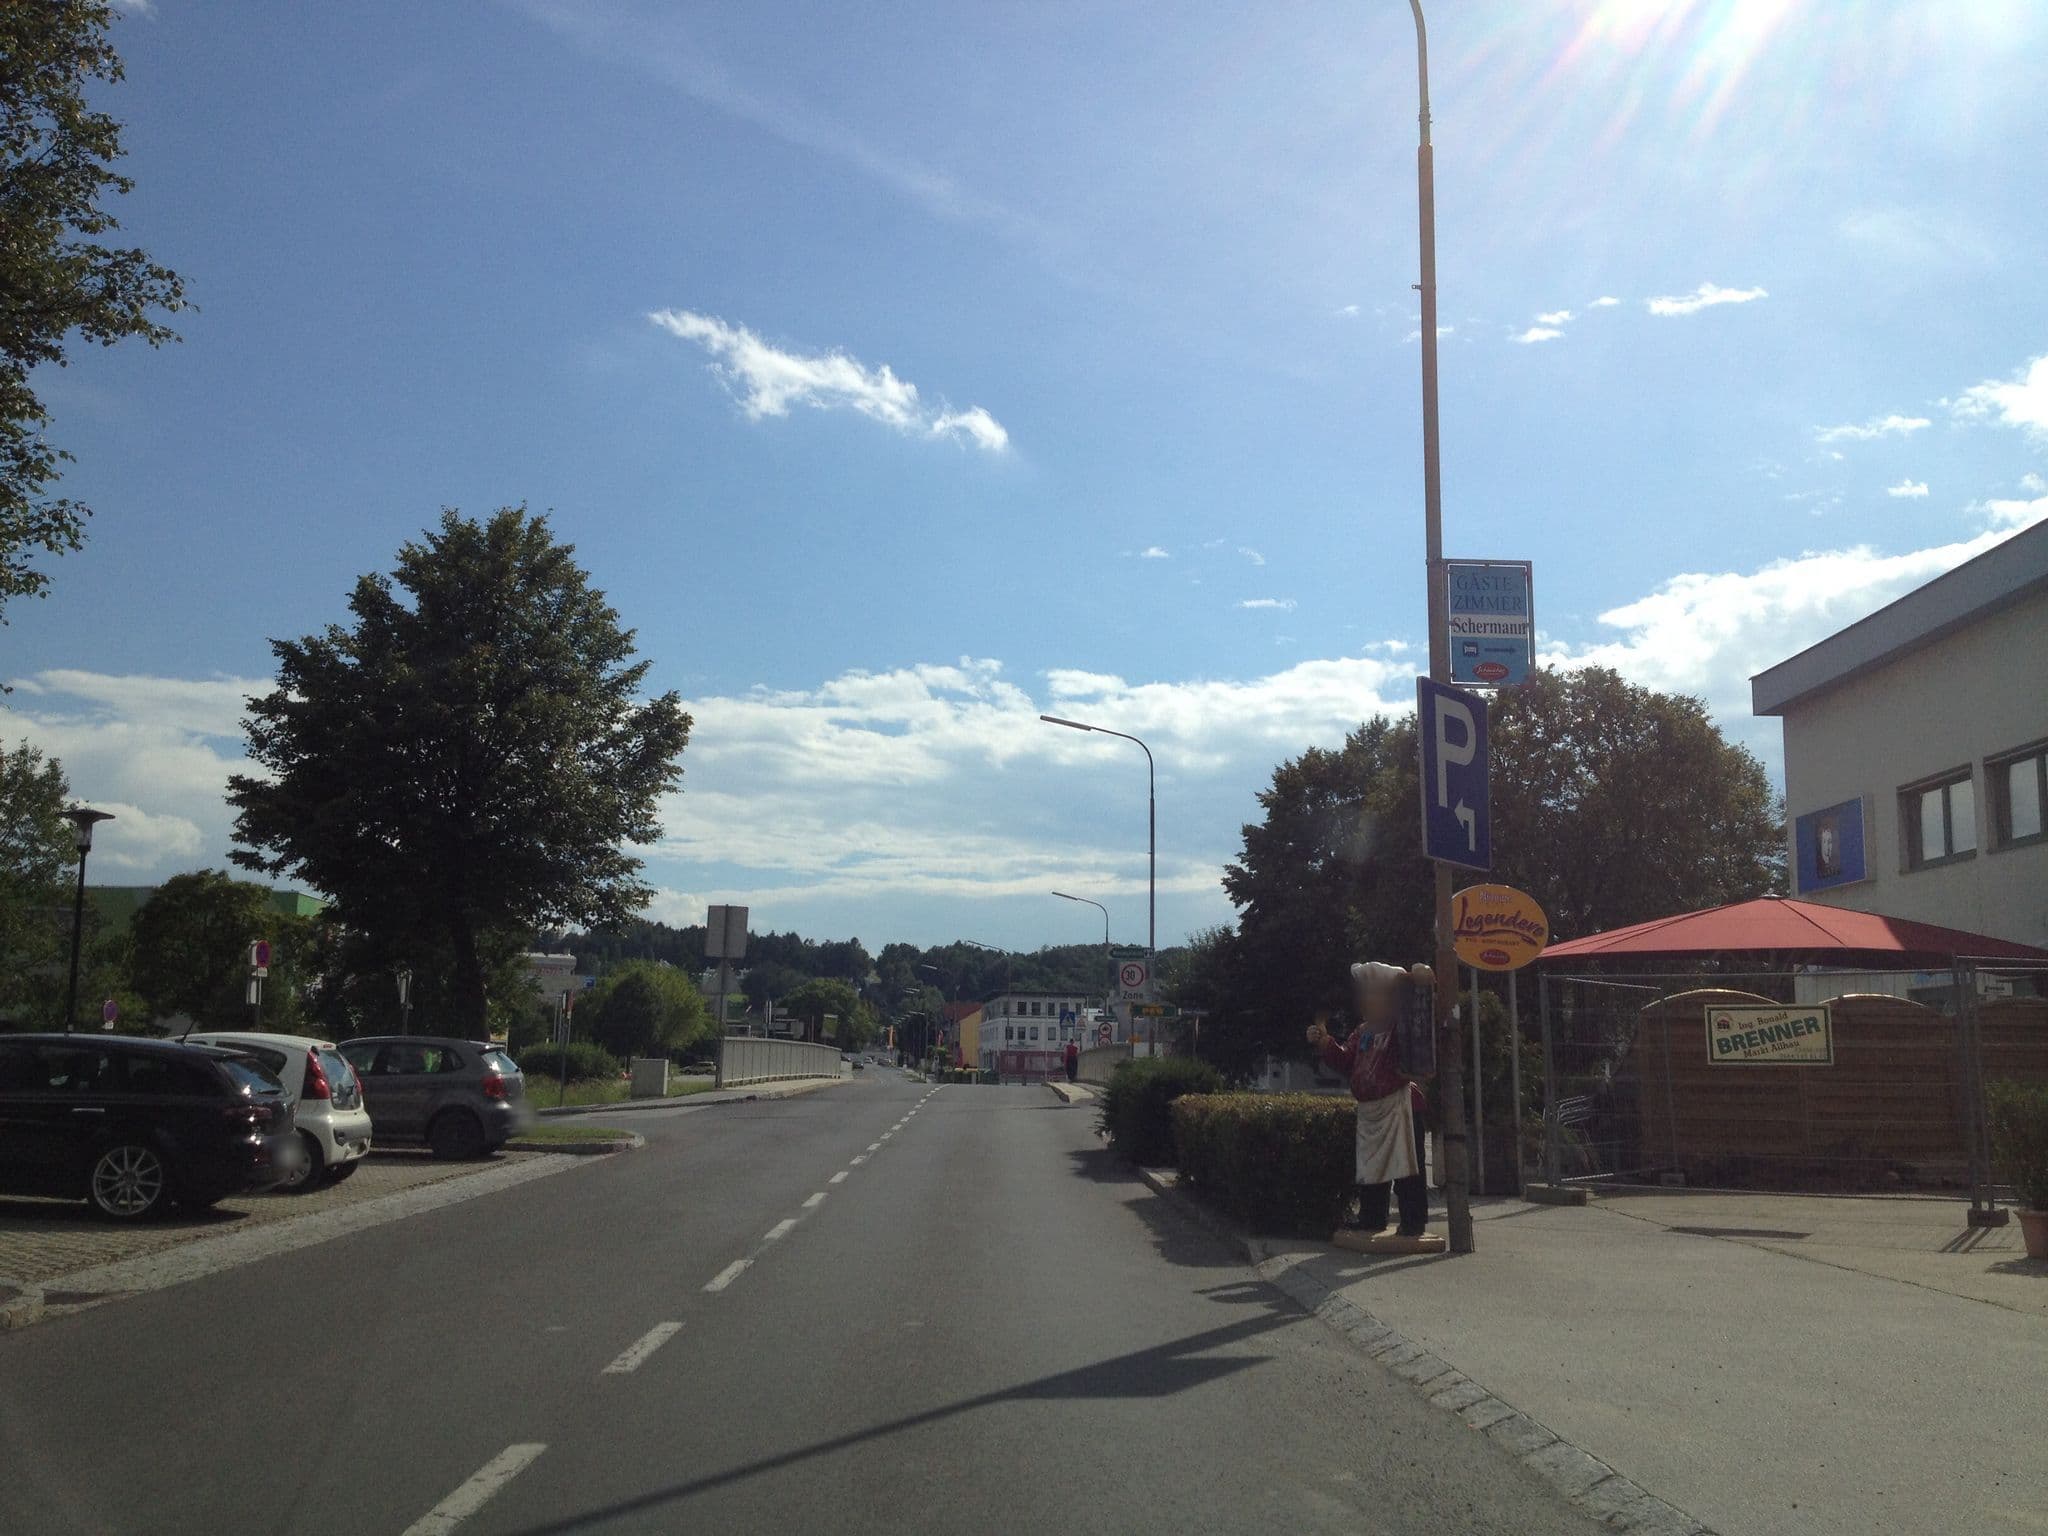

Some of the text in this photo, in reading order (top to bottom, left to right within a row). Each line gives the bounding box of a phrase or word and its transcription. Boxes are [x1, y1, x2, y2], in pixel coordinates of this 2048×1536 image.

[1453, 595, 1522, 611] ZIMMER
[1452, 617, 1527, 635] Schermann
[1434, 693, 1477, 808] P
[1125, 970, 1135, 981] 30
[1123, 990, 1144, 1000] Zone
[1716, 1016, 1821, 1054] BRENNER
